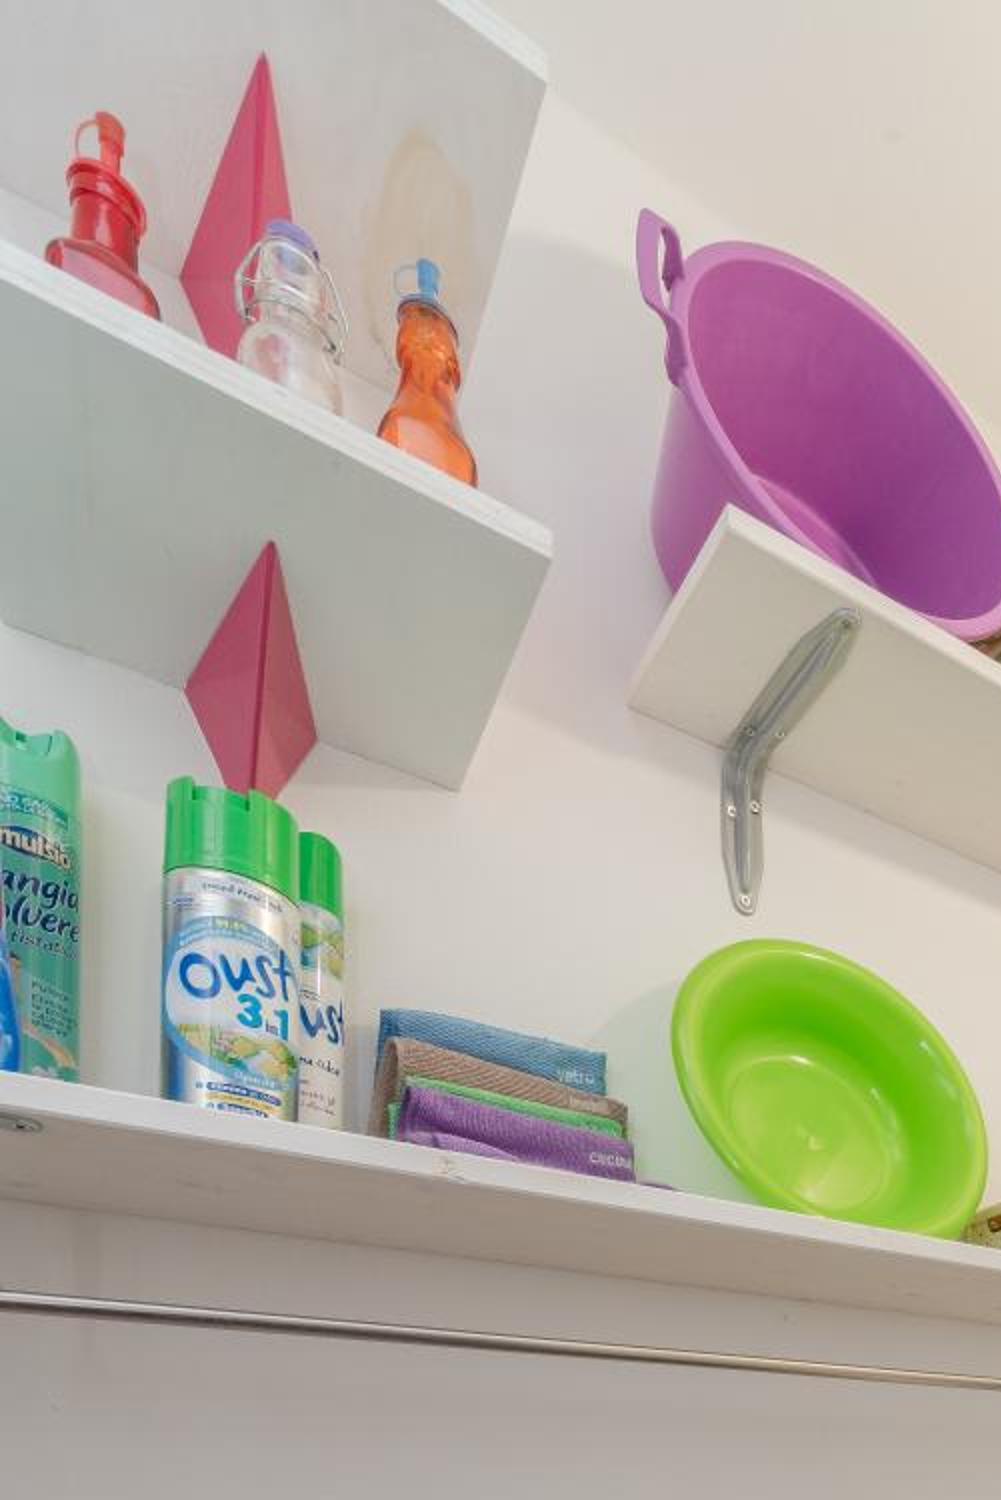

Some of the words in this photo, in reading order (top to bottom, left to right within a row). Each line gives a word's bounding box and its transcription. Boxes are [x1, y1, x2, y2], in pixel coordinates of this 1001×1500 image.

[178, 949, 292, 1003] Oust
[236, 993, 263, 1029] 3
[274, 1009, 289, 1042] 1
